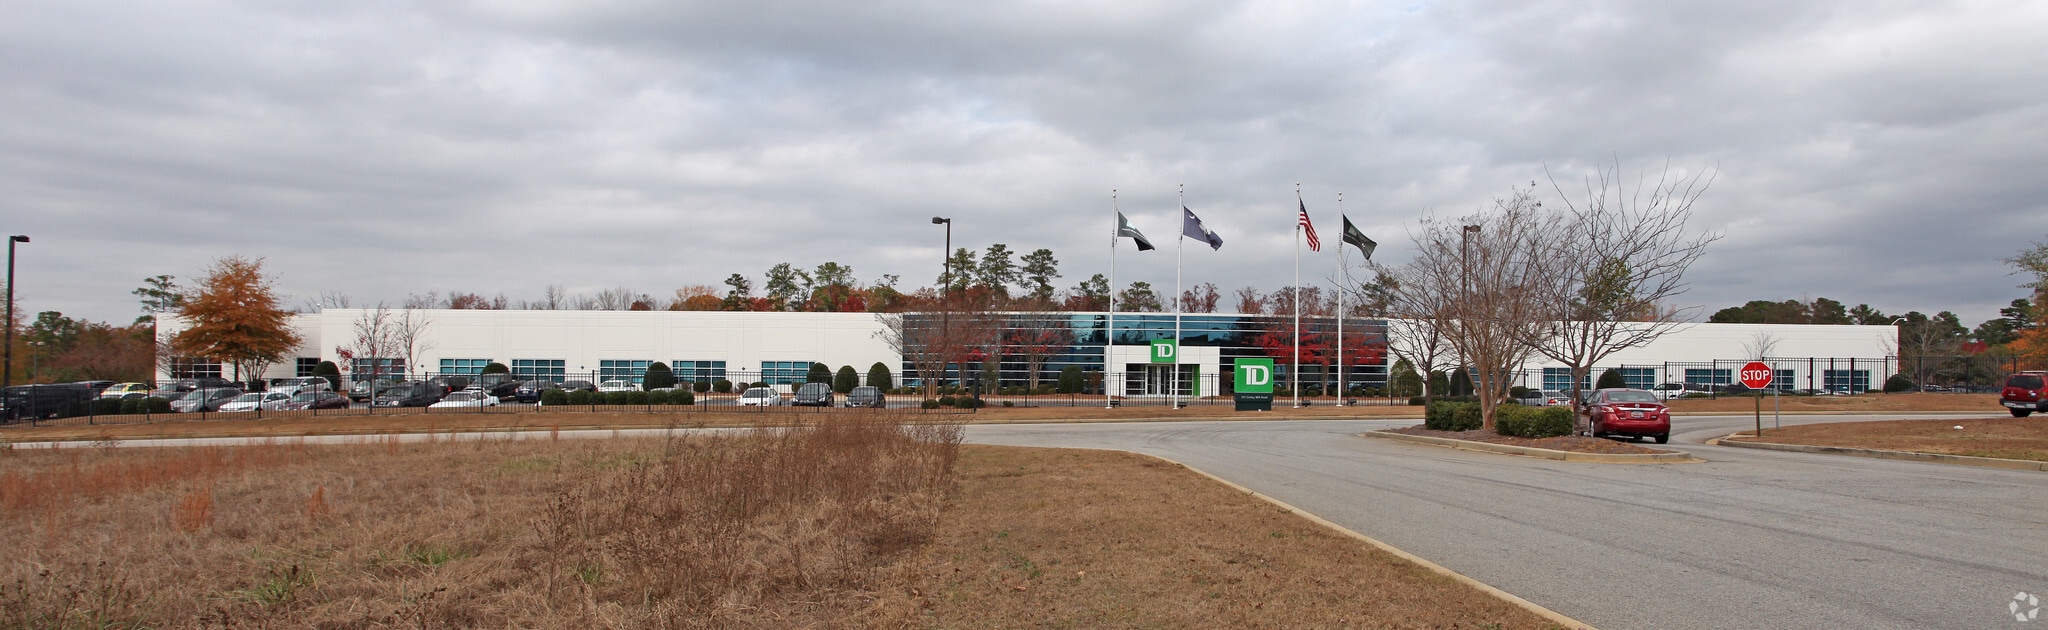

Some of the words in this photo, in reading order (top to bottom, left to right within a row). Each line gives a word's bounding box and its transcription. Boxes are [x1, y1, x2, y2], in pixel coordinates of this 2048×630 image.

[1154, 344, 1174, 357] TD
[1240, 365, 1269, 385] TD
[1742, 370, 1770, 380] STOP
